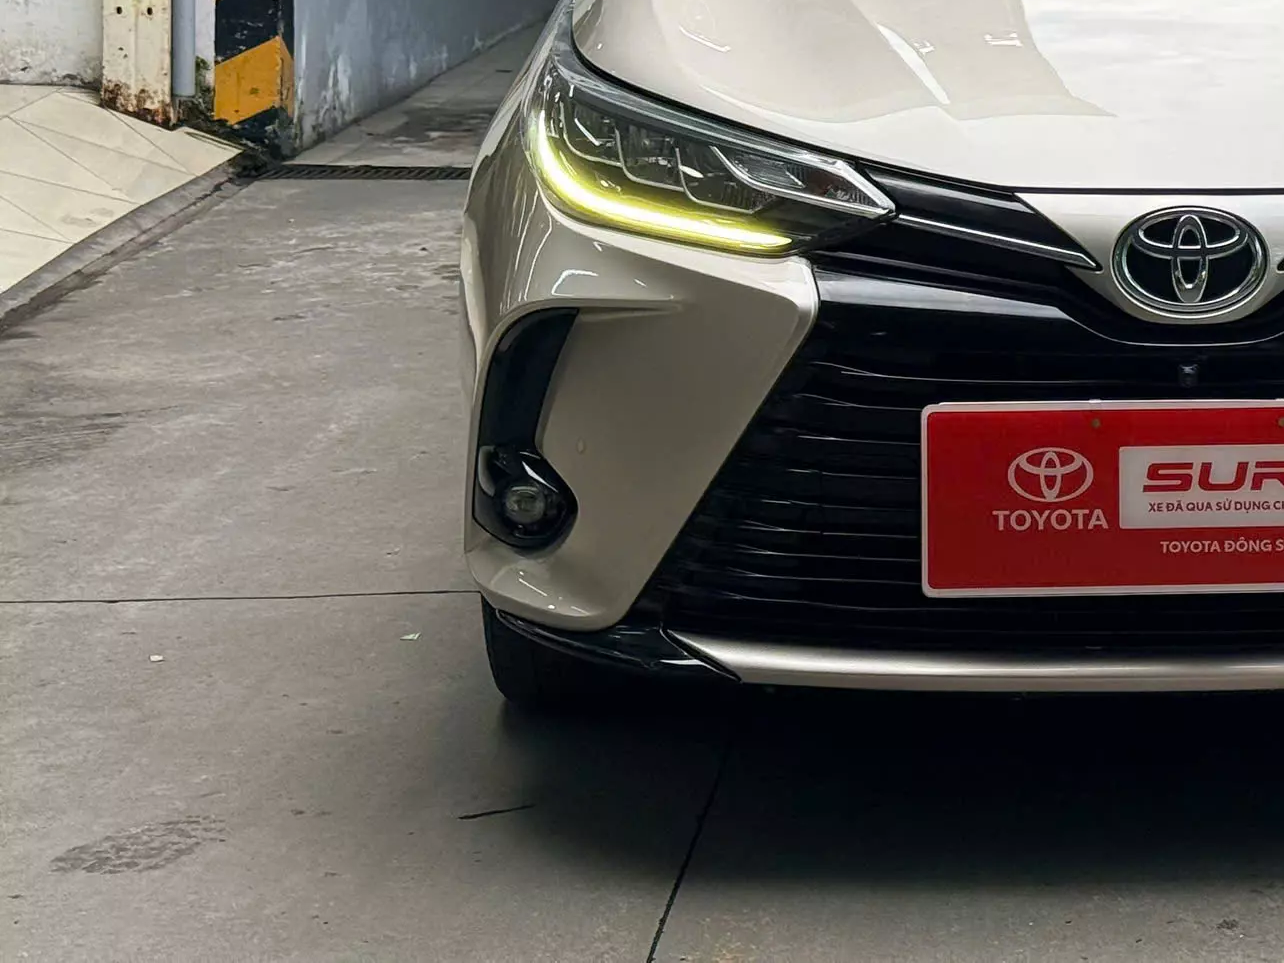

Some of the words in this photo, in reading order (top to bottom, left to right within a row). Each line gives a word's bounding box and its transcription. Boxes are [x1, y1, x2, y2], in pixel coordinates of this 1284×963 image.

[1147, 502, 1164, 514] XE
[1165, 498, 1184, 513] ĐÃ
[1186, 502, 1214, 513] QUA
[1215, 497, 1233, 512] SỬ
[1234, 501, 1271, 516] DỤNG
[992, 508, 1109, 532] TOYOTA
[1160, 540, 1221, 554] TOYOTA
[1223, 536, 1272, 553] ĐÔNG
